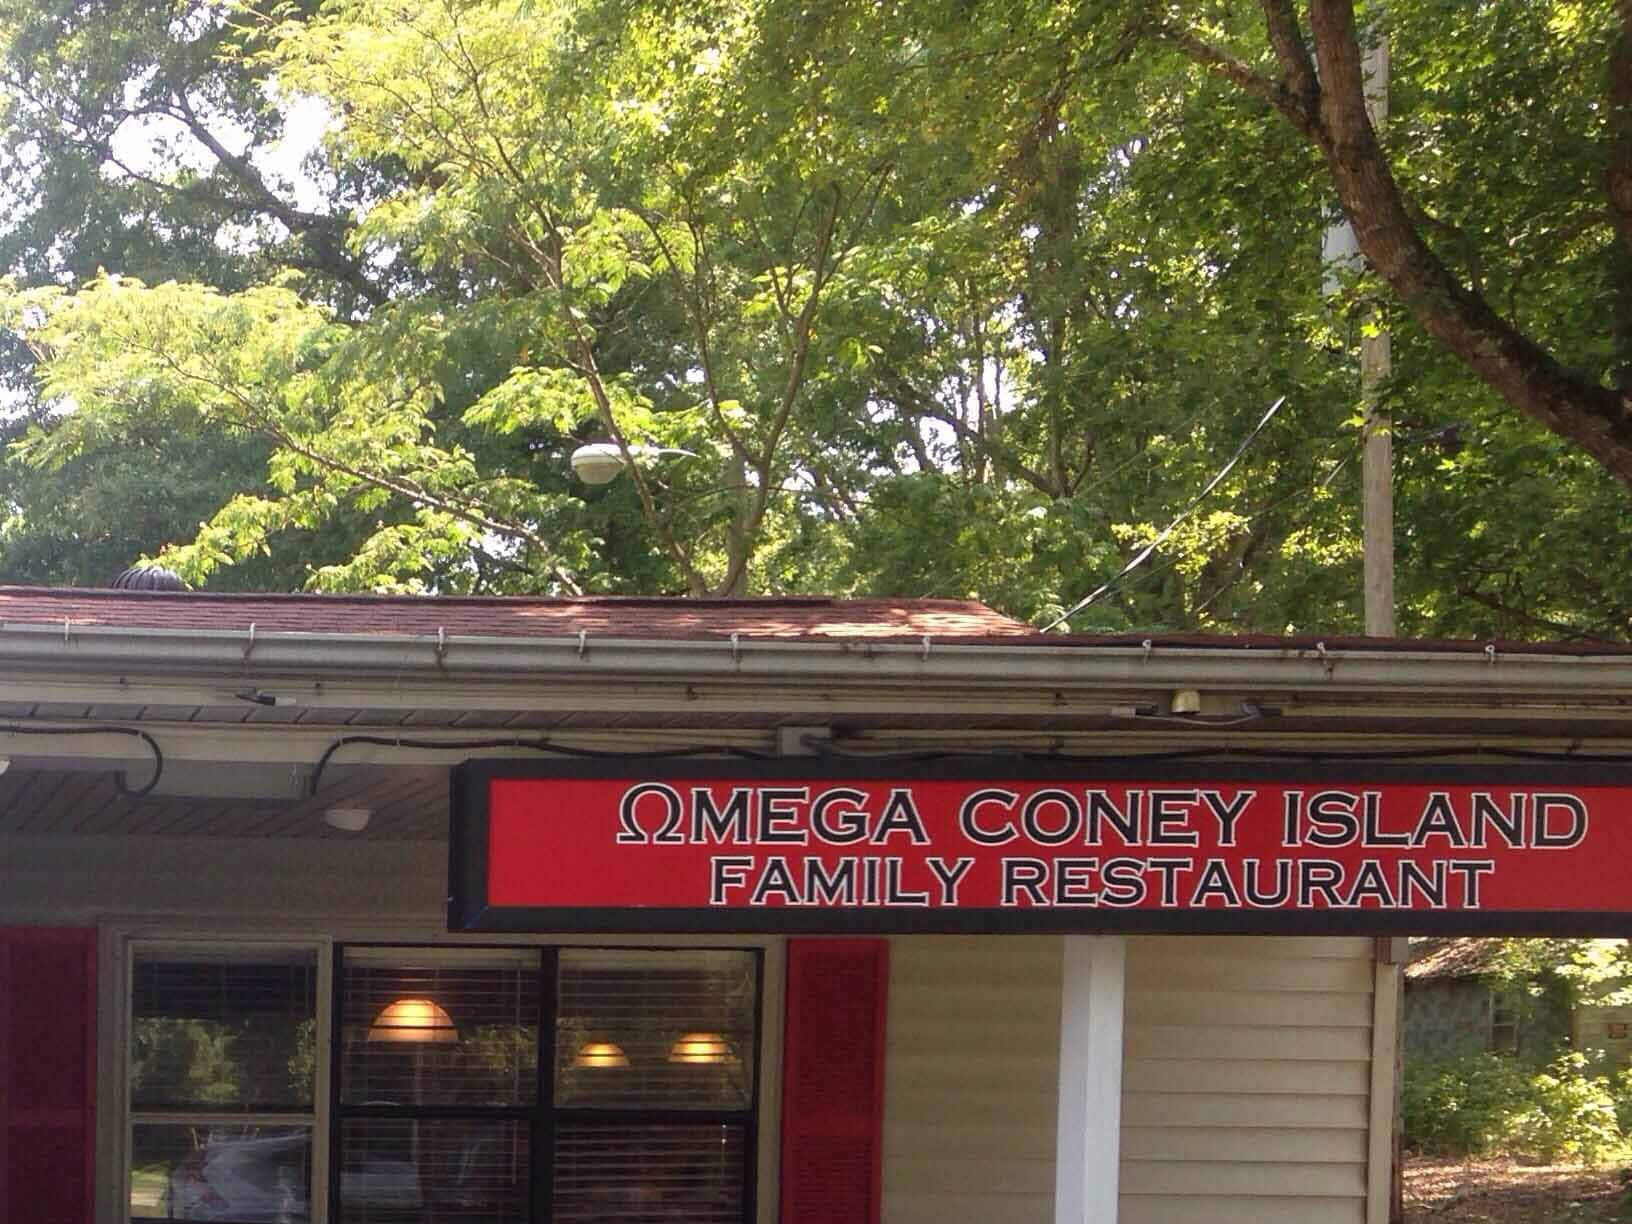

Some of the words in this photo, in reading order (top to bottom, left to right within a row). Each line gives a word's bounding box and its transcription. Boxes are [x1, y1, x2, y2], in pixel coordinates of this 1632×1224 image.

[958, 788, 1257, 848] CONEY
[1281, 790, 1589, 850] ISLAND
[709, 855, 975, 907] FAMILY
[999, 857, 1495, 910] RESTAURANT
